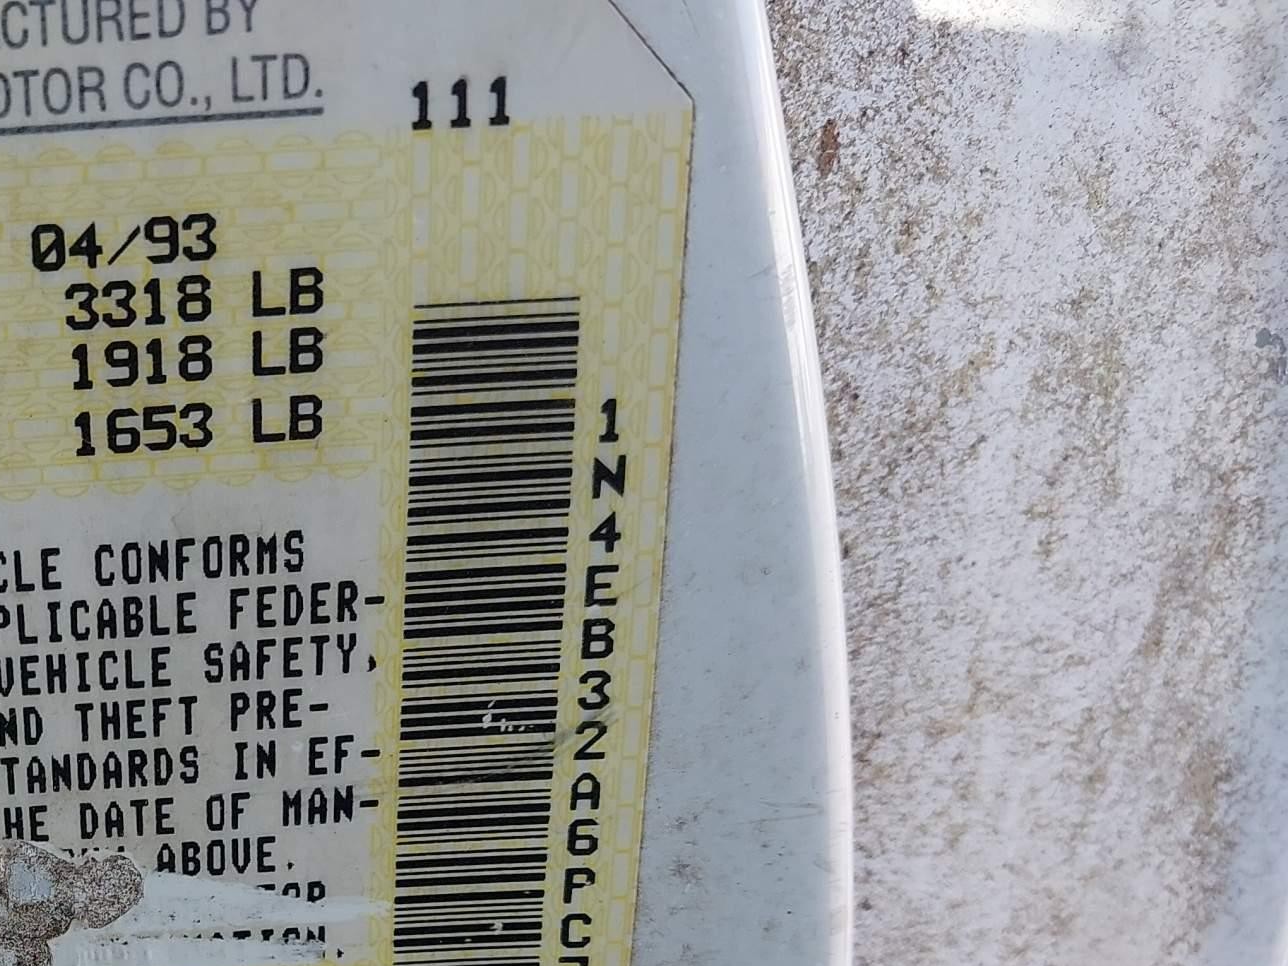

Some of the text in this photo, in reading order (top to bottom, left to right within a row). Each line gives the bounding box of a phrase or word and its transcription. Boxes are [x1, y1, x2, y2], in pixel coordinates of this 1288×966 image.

[205, 0, 258, 36] BY
[124, 60, 211, 111] CO.,
[232, 53, 323, 102] LTD.
[412, 75, 510, 130] 111
[31, 213, 217, 272] 04/93
[65, 274, 212, 331] 3318
[253, 266, 324, 317] LB
[72, 334, 212, 390] 1918
[253, 326, 324, 376] LB
[74, 402, 213, 457] 1653
[252, 395, 323, 443] LB
[94, 530, 305, 587] CONFORMS
[229, 580, 385, 629] FEDER-
[203, 633, 377, 683] SAFETY,
[75, 696, 198, 742] THEFT
[229, 689, 329, 731] PRE-
[234, 740, 276, 781] IN
[308, 735, 381, 776] EF-
[80, 797, 176, 840] DATE
[206, 791, 251, 832] OF
[282, 785, 379, 827] MAN-
[156, 836, 294, 876] ABOVE.
